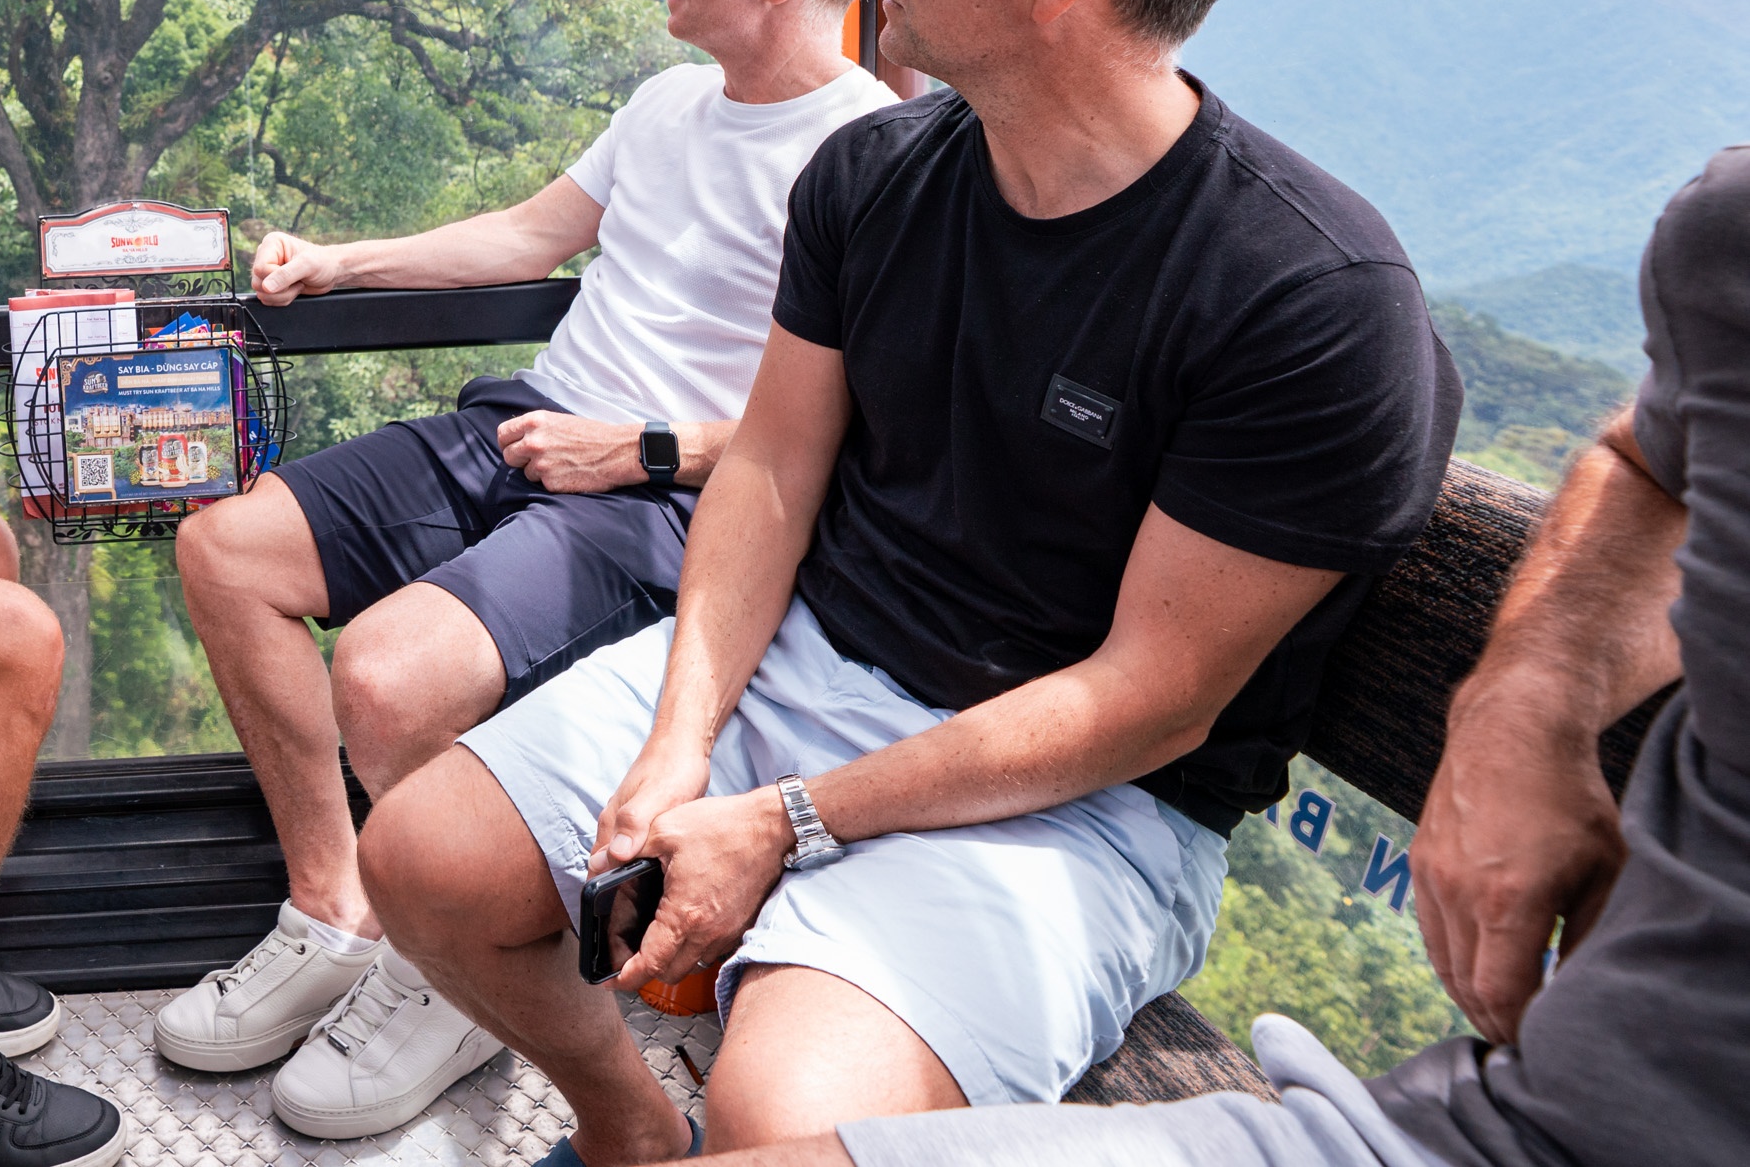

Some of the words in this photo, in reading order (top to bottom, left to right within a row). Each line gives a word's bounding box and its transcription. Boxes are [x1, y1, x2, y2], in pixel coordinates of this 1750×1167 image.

[118, 366, 134, 375] SAY
[135, 365, 150, 373] BIA
[183, 363, 199, 371] SAY
